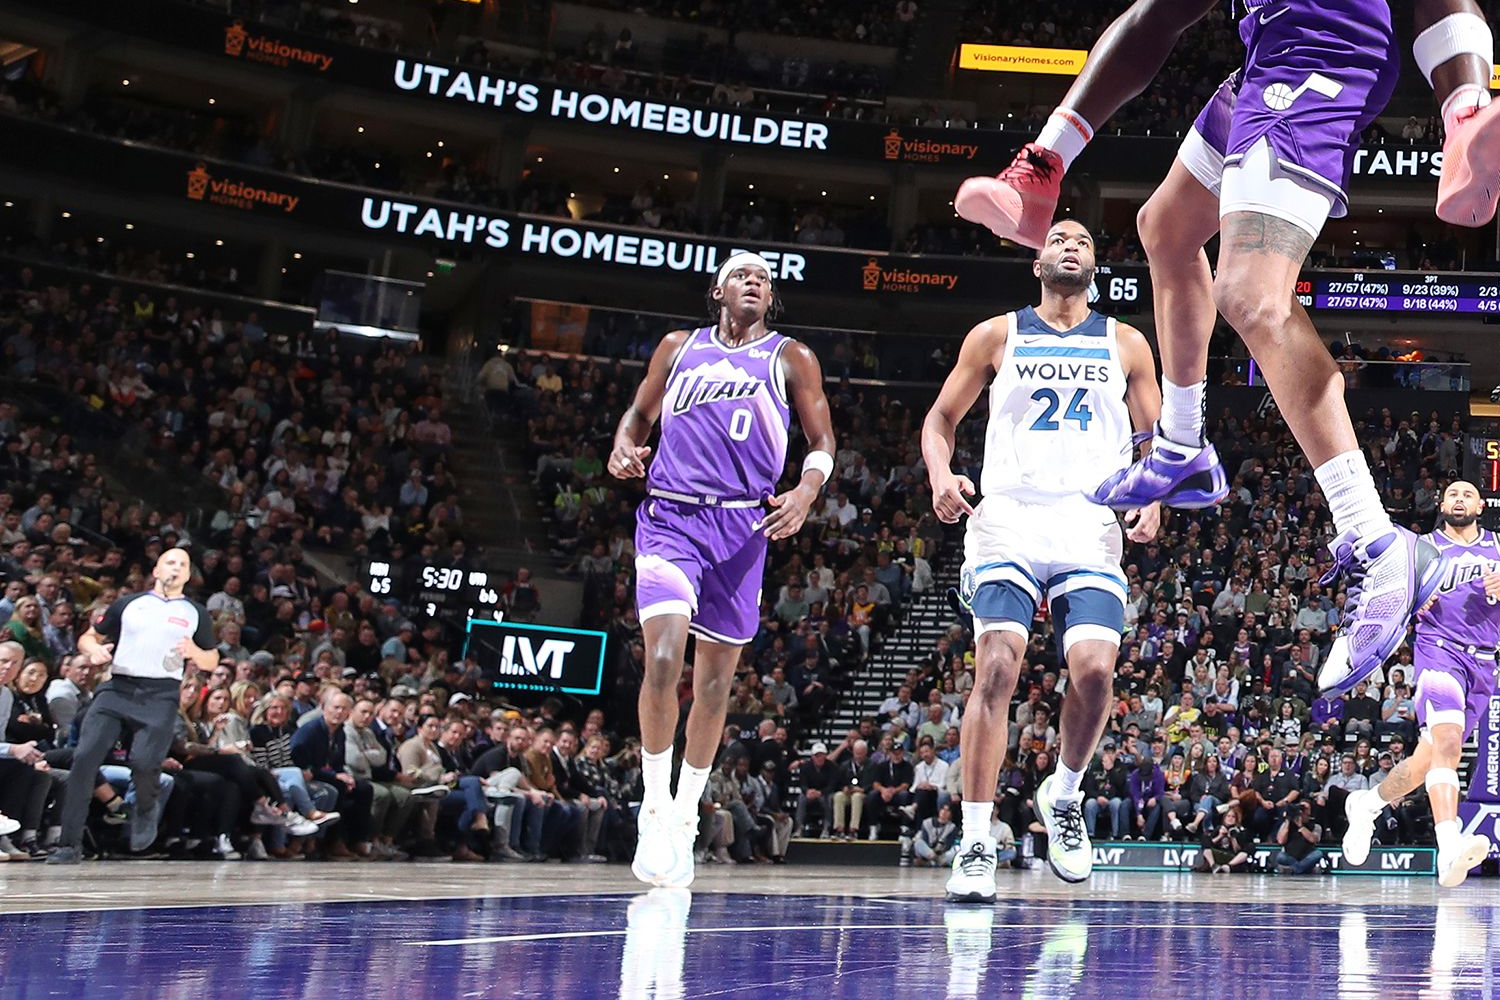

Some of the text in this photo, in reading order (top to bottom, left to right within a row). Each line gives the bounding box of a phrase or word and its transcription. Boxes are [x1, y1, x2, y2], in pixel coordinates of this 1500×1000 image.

[248, 37, 334, 71] visionary
[973, 53, 1074, 66] VisionaryHomes.com
[393, 59, 830, 150] UTAH'S HOMEBUILDER
[904, 138, 978, 159] visionary
[904, 153, 940, 163] HOMES
[210, 179, 300, 212] visionary
[360, 198, 510, 248] UTAH'S
[882, 270, 958, 290] visionary
[882, 283, 919, 292] HOMES
[1109, 278, 1138, 301] 65
[1297, 281, 1310, 293] 20
[1328, 283, 1359, 294] 27/57
[1360, 283, 1389, 295] (47%)
[1403, 285, 1429, 296] 9/23
[1430, 285, 1459, 296] (39%)
[1479, 286, 1498, 297] 2/3
[1354, 274, 1363, 282] FG
[1425, 275, 1438, 283] 3PT
[1327, 296, 1358, 307] 27/57
[1359, 297, 1388, 309] (47%)
[1403, 298, 1427, 309] 8/18
[1428, 299, 1457, 311] (44%)
[1478, 300, 1497, 311] 4/5
[1016, 363, 1109, 382] WOLVES
[672, 375, 766, 416] UTAH
[1029, 388, 1092, 431] 24
[729, 408, 753, 441] 0
[421, 566, 464, 591] 5:30
[499, 635, 576, 679] LVT
[1487, 695, 1500, 796] AMERICA FIRST
[1163, 849, 1198, 866] LVT
[1381, 852, 1415, 870] LVT
